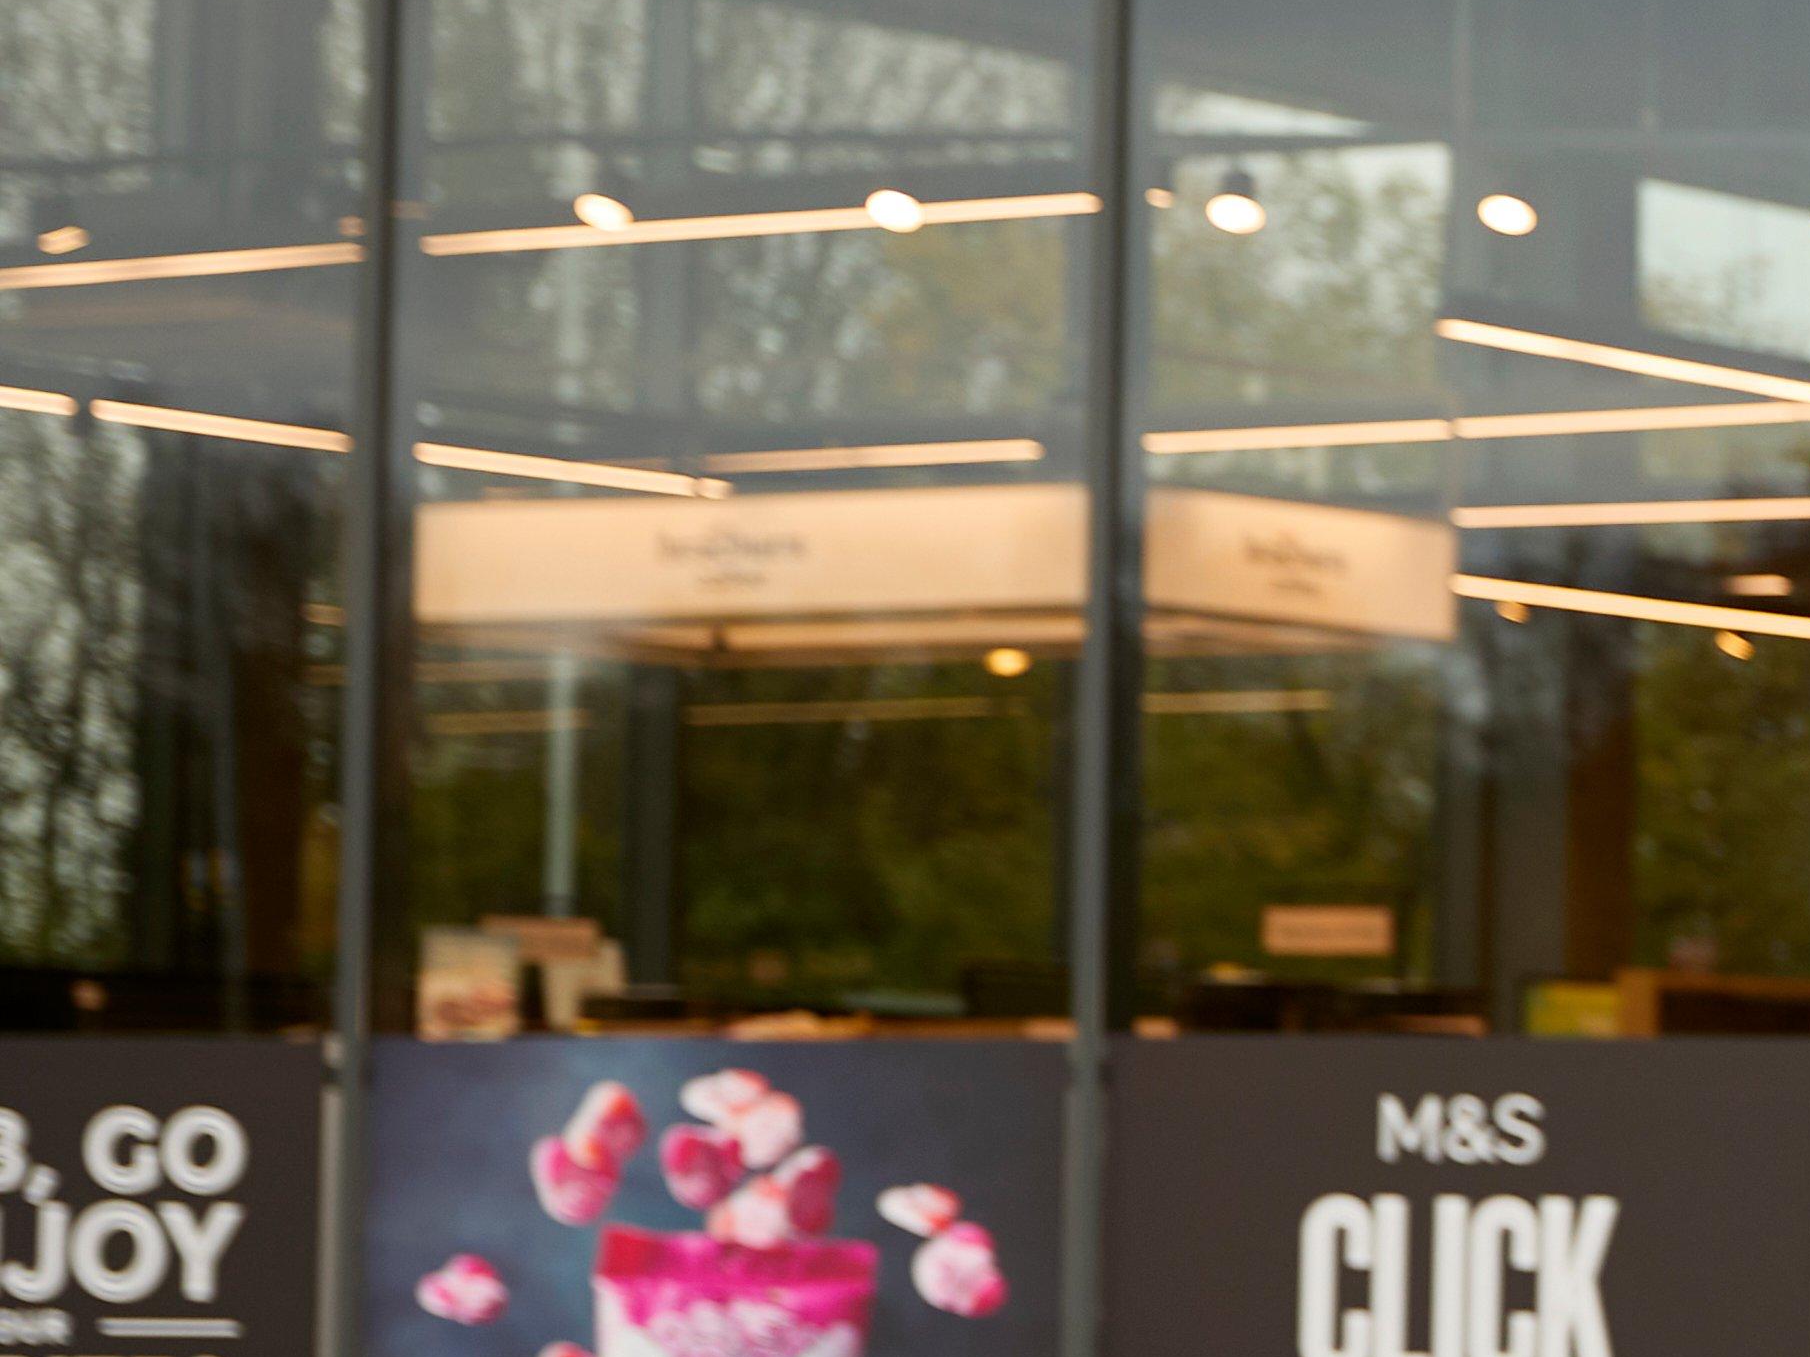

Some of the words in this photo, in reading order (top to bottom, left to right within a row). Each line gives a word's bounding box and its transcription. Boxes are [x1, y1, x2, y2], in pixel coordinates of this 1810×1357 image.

[81, 1104, 250, 1197] GO
[1375, 1091, 1549, 1166] M&S
[0, 1200, 247, 1304] JOY
